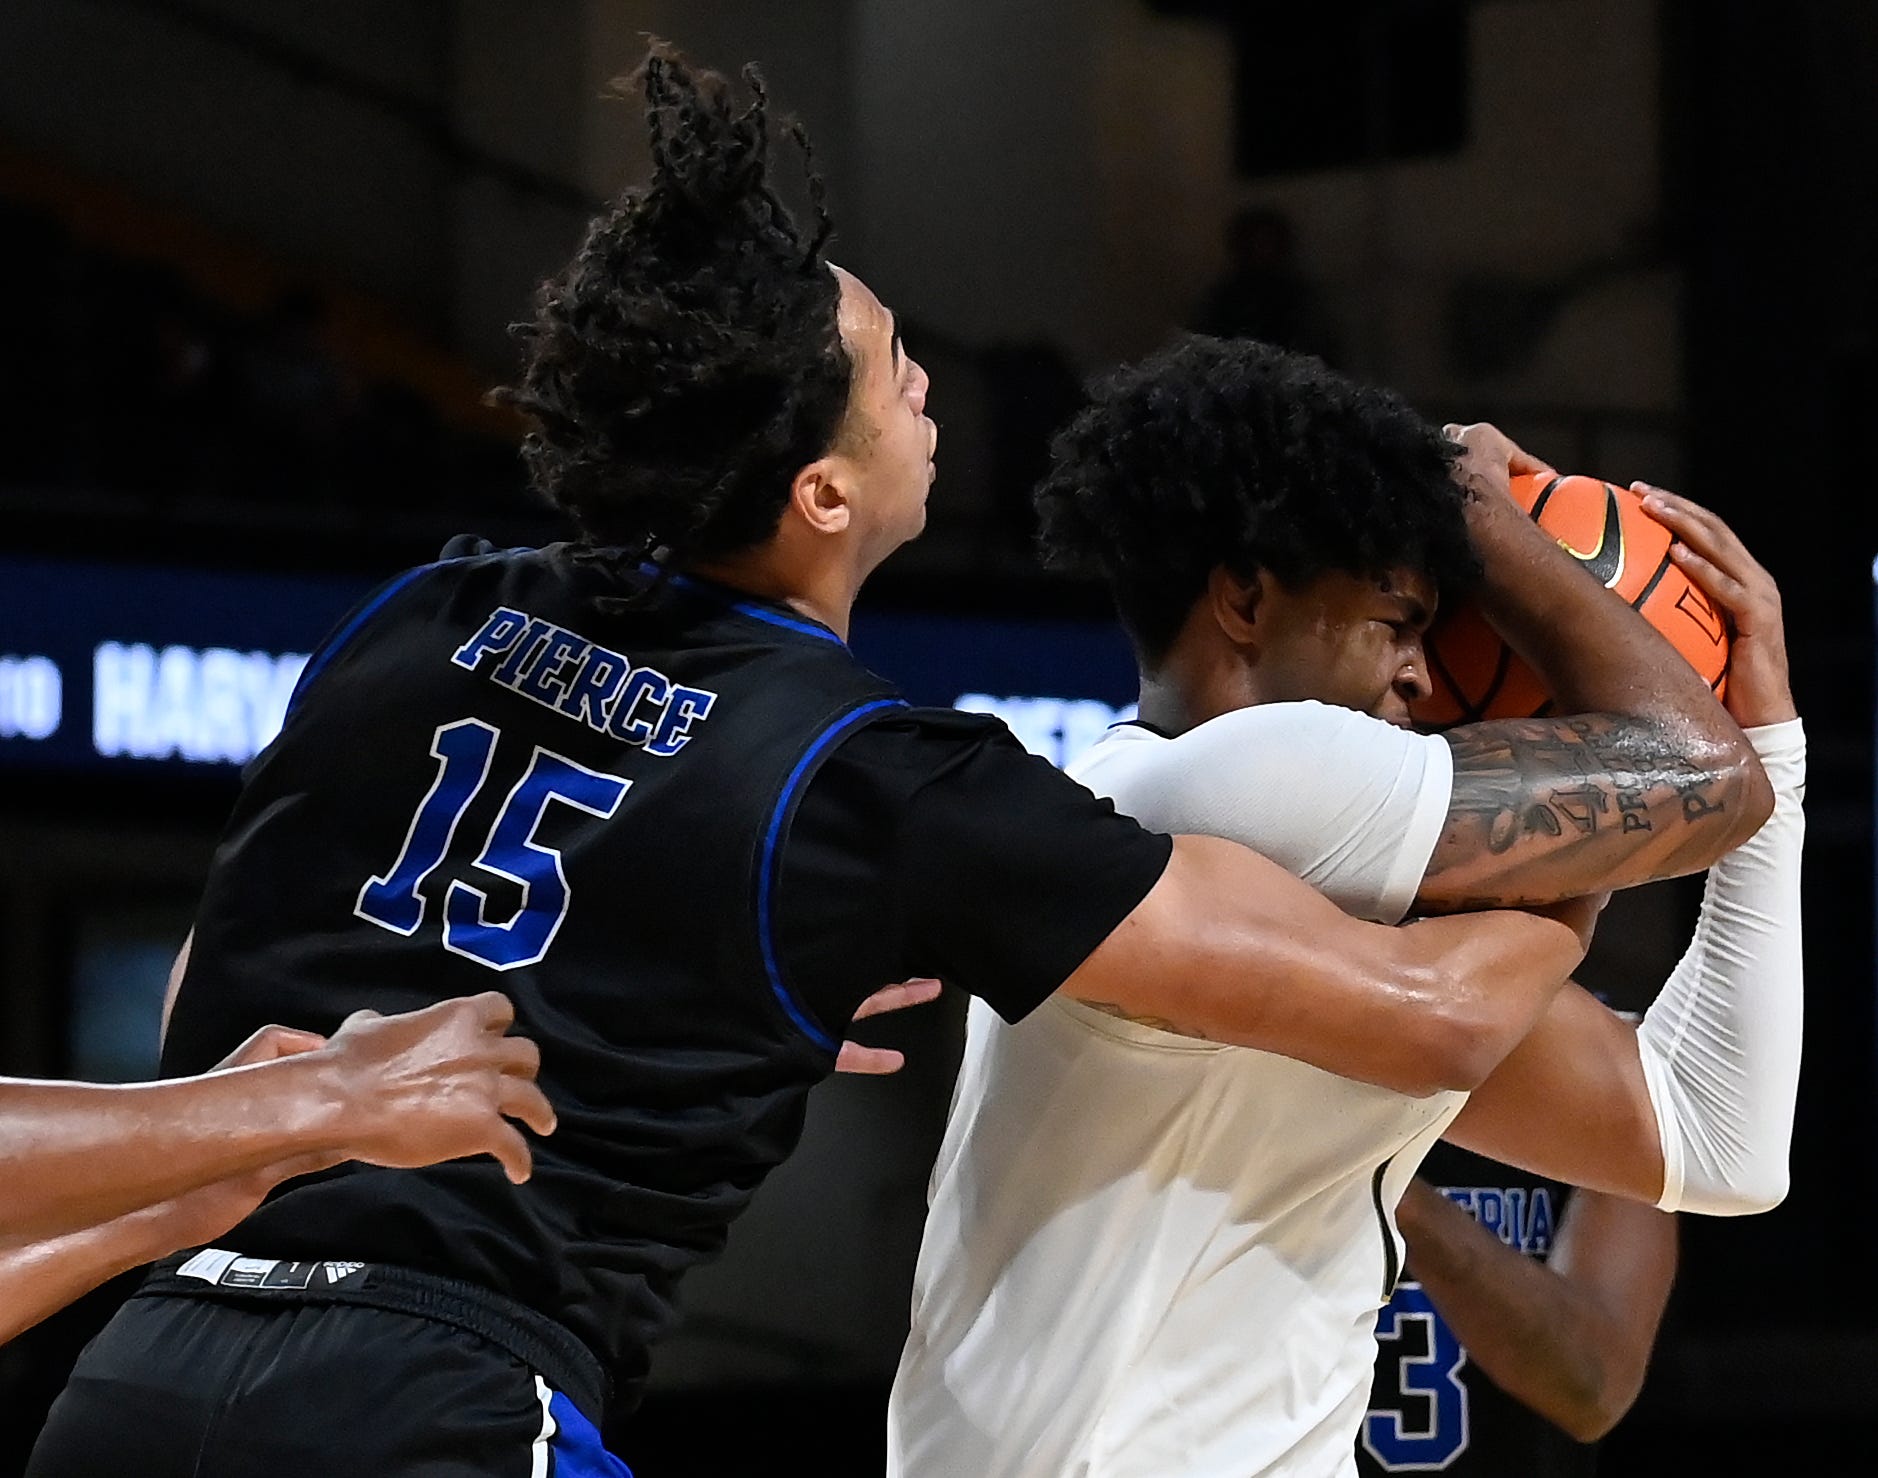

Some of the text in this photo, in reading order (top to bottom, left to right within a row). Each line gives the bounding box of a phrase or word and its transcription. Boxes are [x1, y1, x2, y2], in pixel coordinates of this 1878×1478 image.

[449, 606, 718, 757] PIERCE
[353, 717, 634, 971] 15
[1361, 1281, 1470, 1473] 3
